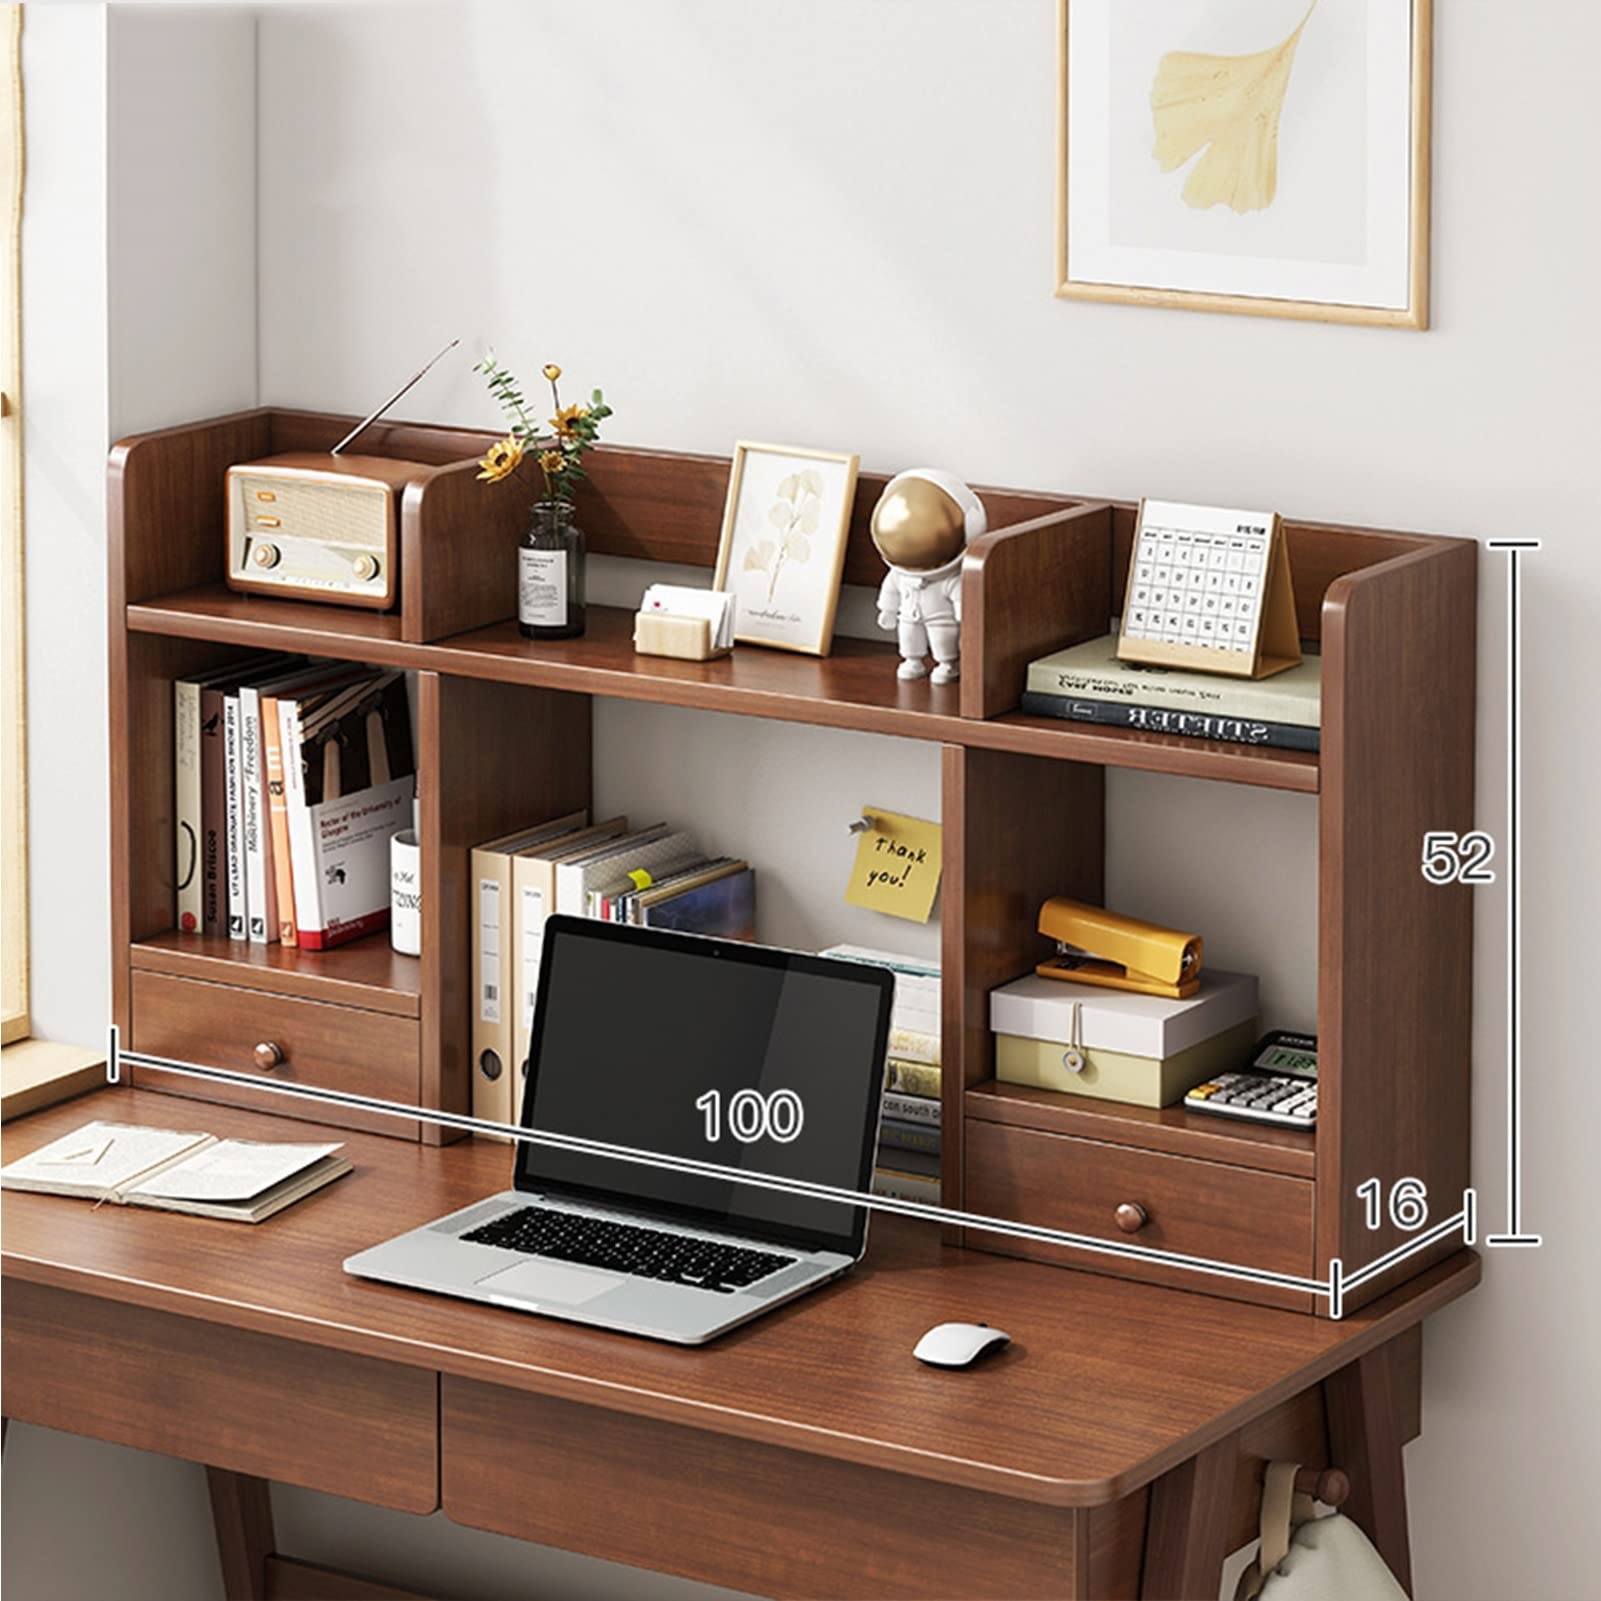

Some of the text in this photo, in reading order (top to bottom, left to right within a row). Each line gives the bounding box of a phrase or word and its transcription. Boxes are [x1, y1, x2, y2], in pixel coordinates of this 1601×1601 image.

[227, 727, 236, 756] SHOW
[207, 829, 218, 923] Susan Briscoe
[867, 864, 912, 888] you!
